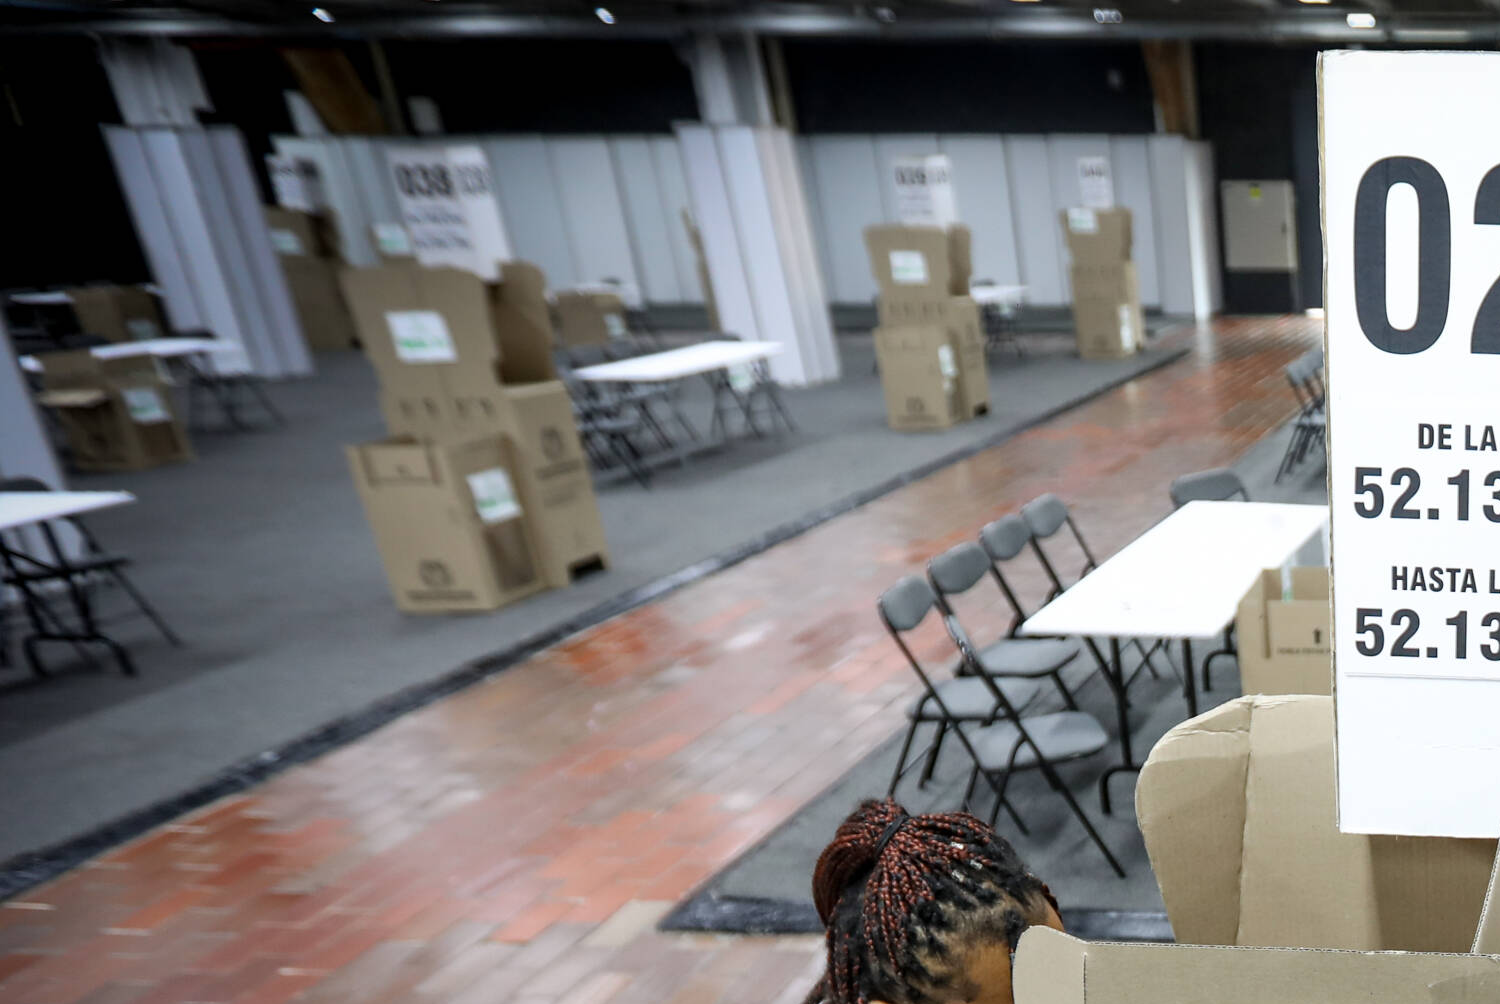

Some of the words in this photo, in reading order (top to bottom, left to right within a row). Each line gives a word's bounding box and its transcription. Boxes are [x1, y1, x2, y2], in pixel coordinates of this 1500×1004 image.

[1418, 423, 1452, 450] DE
[1464, 424, 1498, 452] LA
[1391, 565, 1478, 594] HASTA
